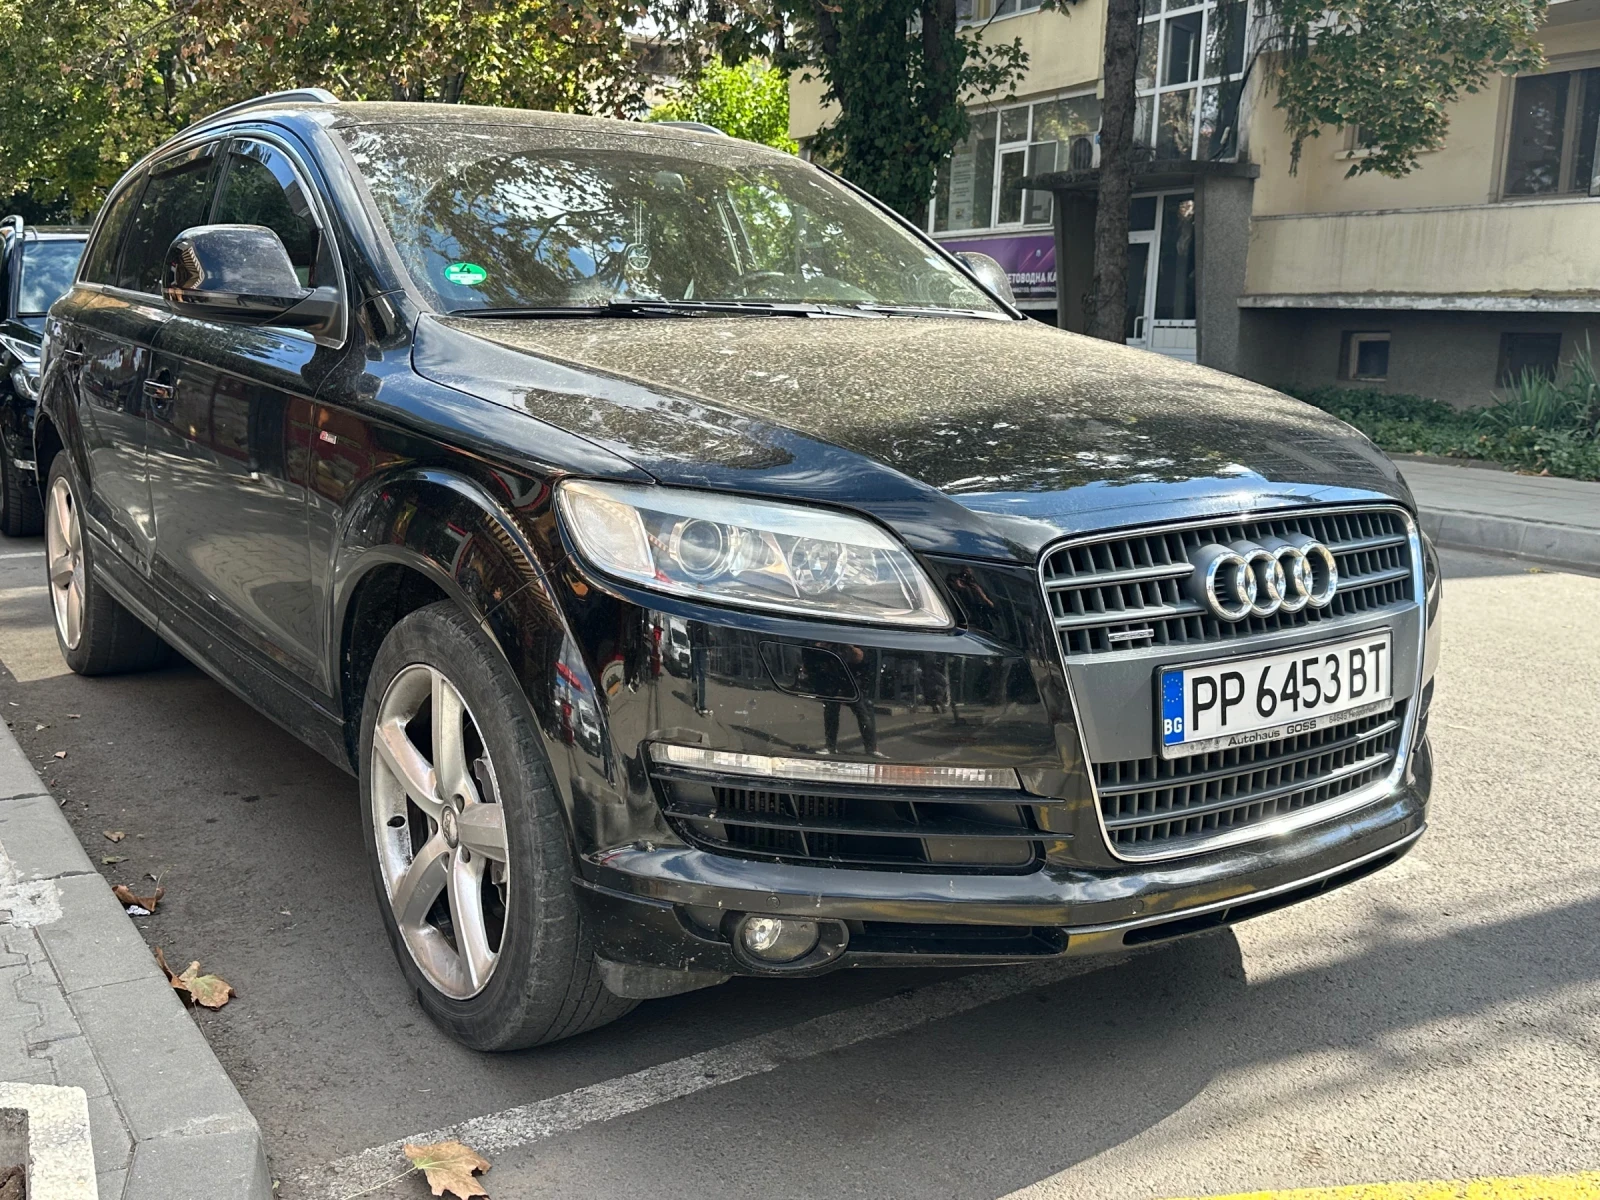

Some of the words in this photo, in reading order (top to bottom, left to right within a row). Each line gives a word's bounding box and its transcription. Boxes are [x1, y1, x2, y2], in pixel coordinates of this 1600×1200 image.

[1006, 272, 1046, 285] ЕТОВОДНА
[1192, 671, 1245, 731] PP
[1256, 653, 1341, 718] 6453
[1349, 642, 1386, 699] BT
[1164, 717, 1182, 735] BG
[1228, 730, 1280, 746] Autohaus
[1286, 720, 1316, 734] GOSS
